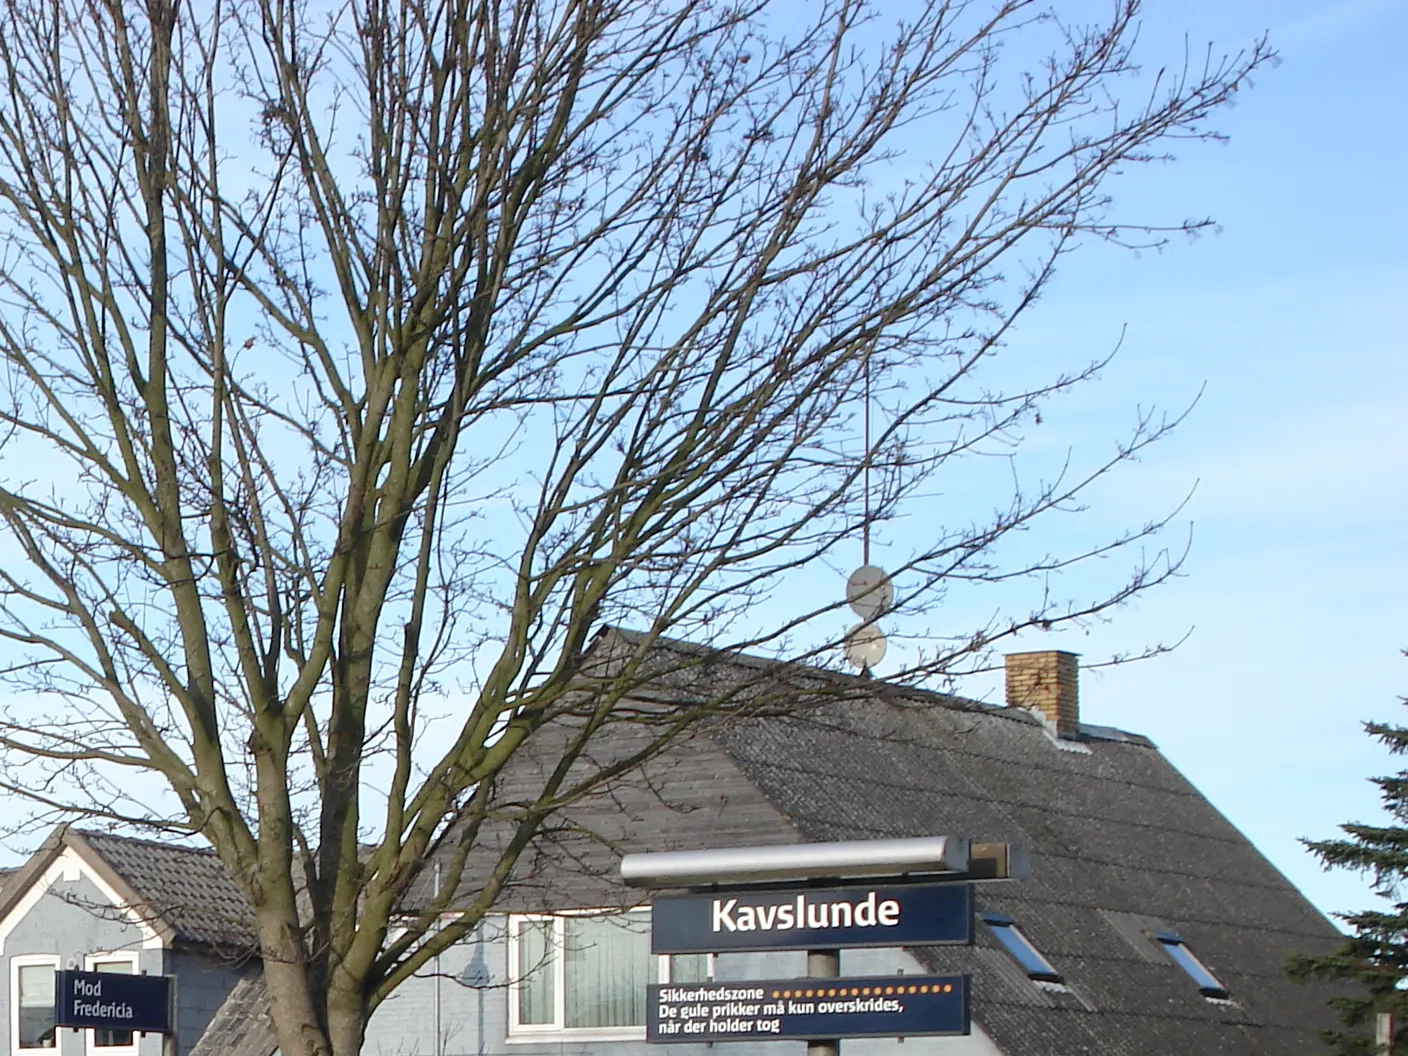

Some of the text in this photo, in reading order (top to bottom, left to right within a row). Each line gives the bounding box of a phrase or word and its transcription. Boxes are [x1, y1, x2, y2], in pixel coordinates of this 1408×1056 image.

[712, 891, 900, 932] Kavslunde
[73, 979, 102, 997] Mod
[658, 987, 764, 1003] Sikkerhedszone
[73, 999, 133, 1019] Fredericia
[658, 998, 904, 1020] De gule prikker må kun overskrides,
[658, 1017, 781, 1034] når der holder tog
